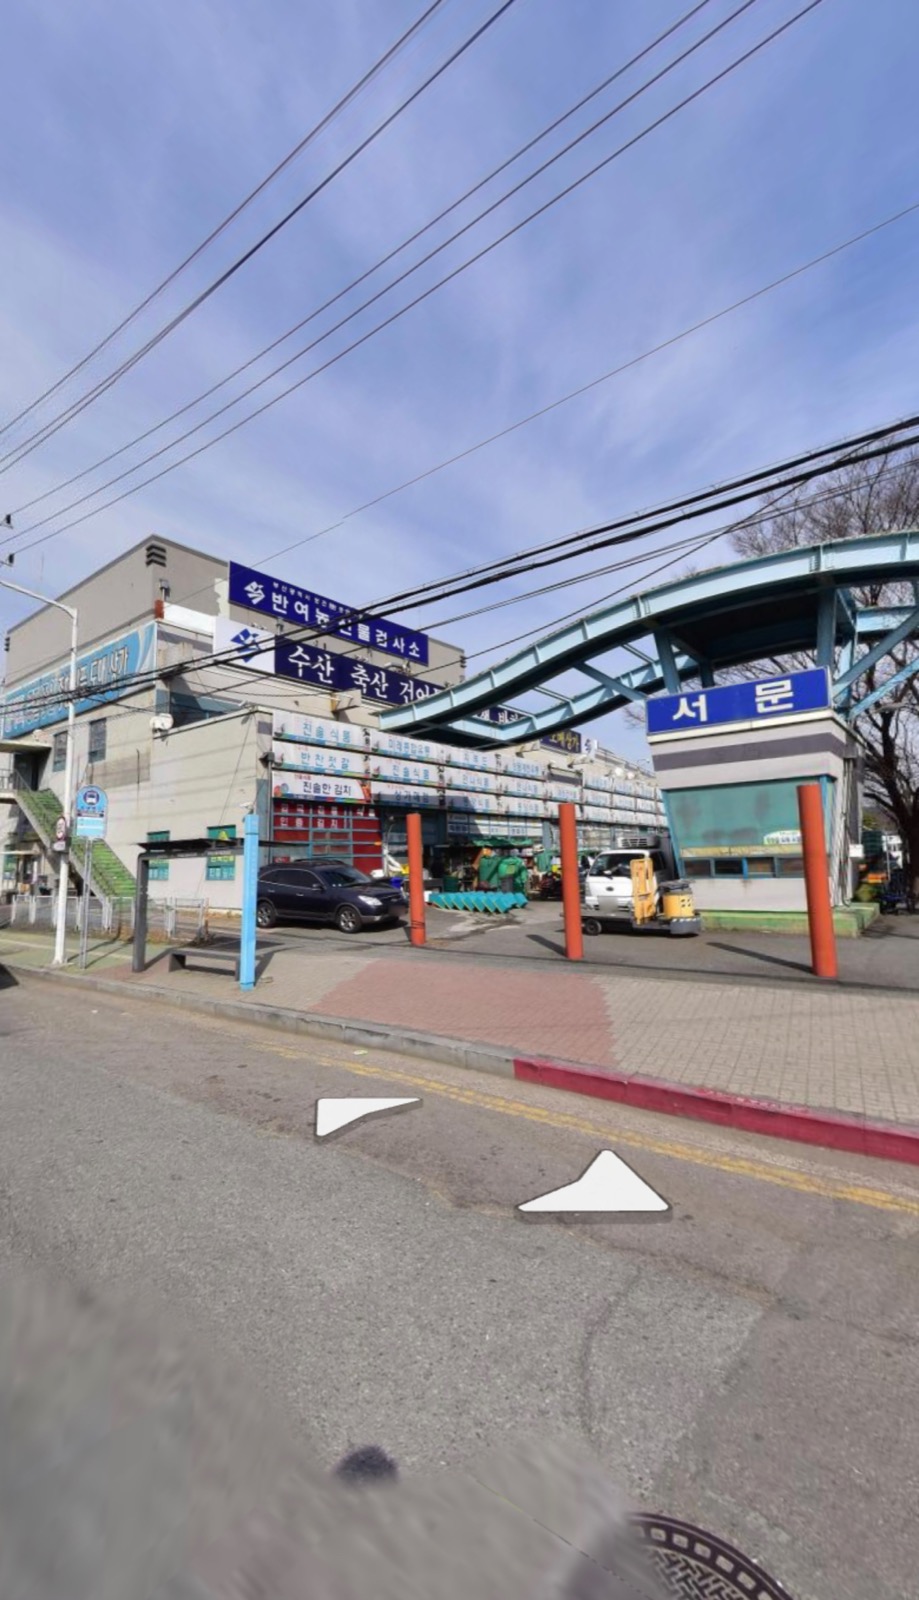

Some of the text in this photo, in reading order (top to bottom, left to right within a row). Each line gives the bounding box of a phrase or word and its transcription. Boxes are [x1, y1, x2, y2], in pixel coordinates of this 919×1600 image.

[288, 645, 336, 684] 수산
[351, 664, 390, 699] 축산
[303, 781, 352, 796] 진솔한 김치
